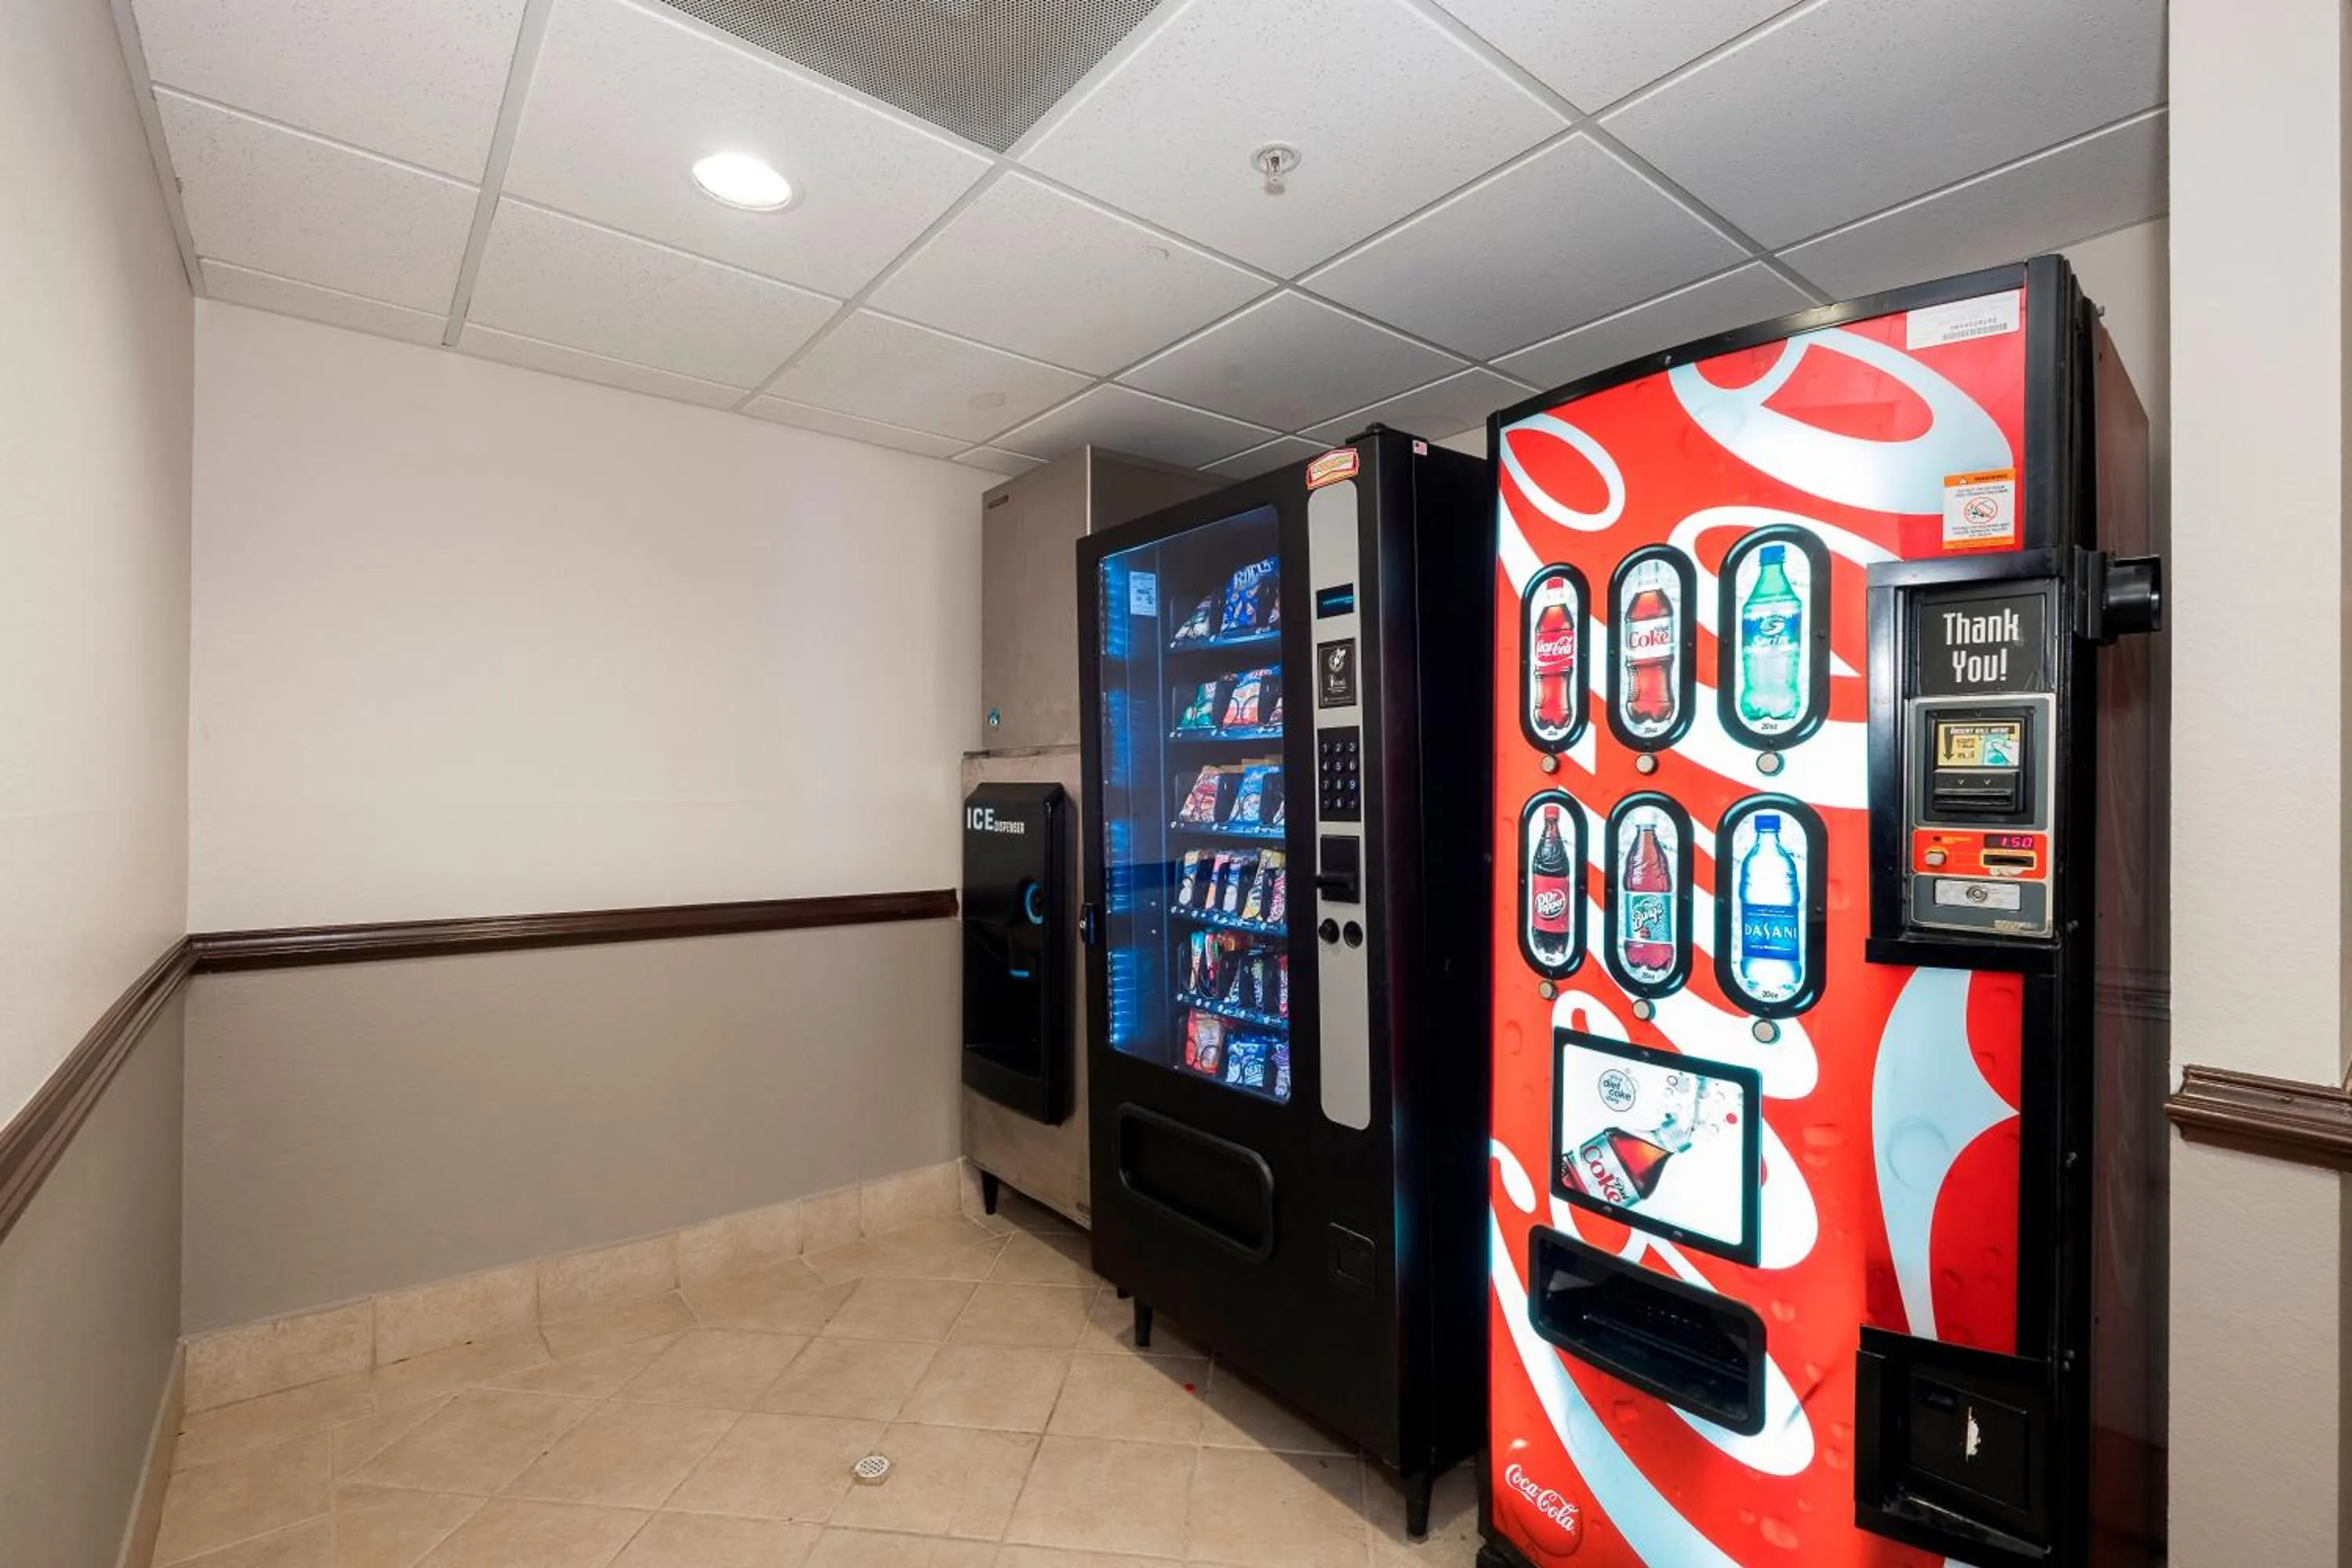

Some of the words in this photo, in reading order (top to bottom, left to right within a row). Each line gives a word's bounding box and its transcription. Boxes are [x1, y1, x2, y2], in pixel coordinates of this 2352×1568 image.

[1629, 630, 1668, 648] Coke
[1943, 608, 2019, 645] Thank
[1953, 648, 2008, 683] You!
[967, 807, 995, 830] ICE
[2002, 837, 2033, 848] 1.50
[1744, 923, 1797, 940] DASANI
[1583, 1145, 1622, 1203] Coke
[1504, 1463, 1579, 1531] Coca-Cola
